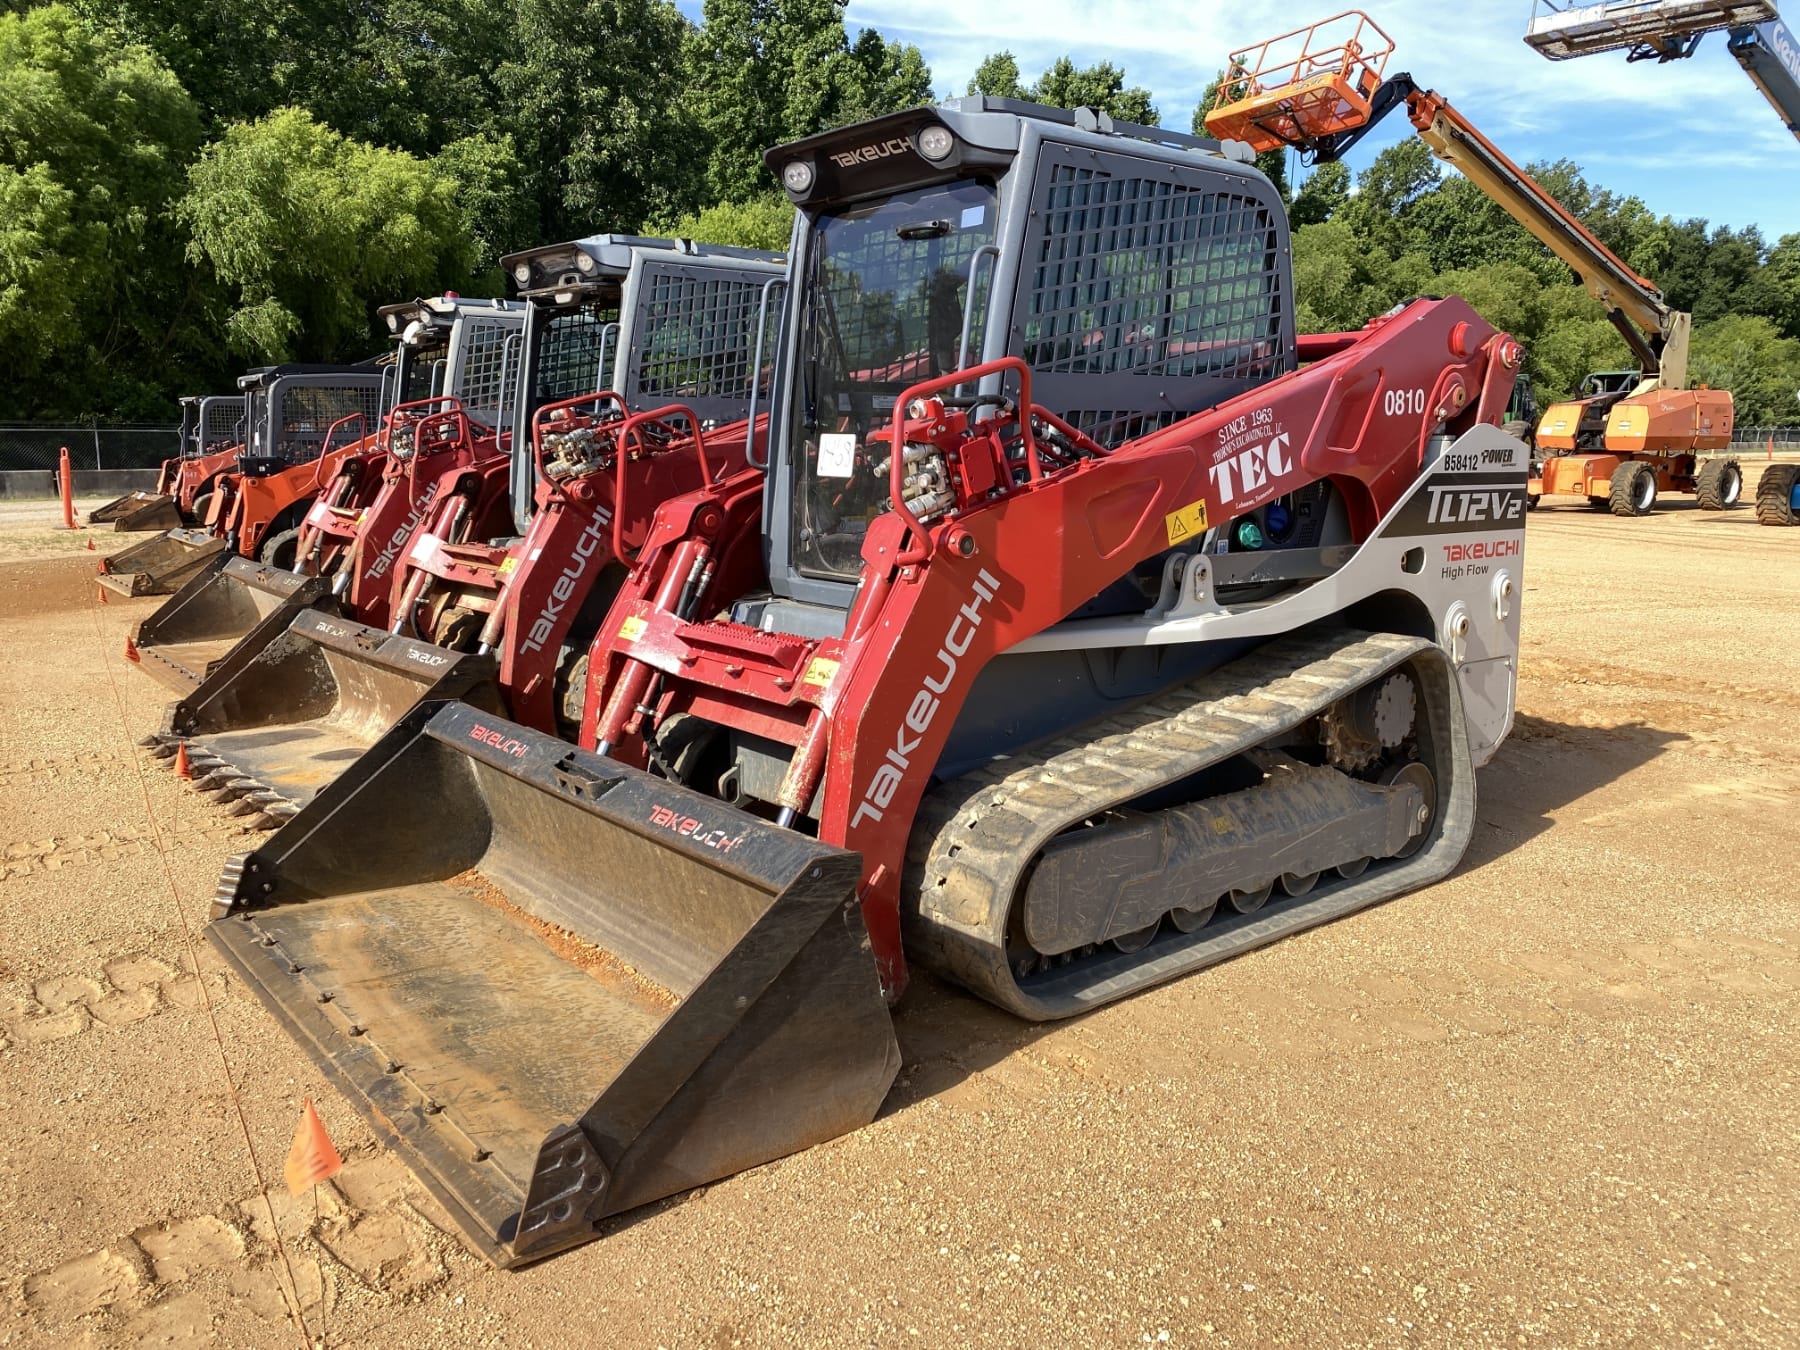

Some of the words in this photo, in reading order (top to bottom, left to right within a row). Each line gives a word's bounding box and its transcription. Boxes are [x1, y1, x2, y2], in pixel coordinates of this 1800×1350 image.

[830, 136, 915, 168] TAKEUCH
[1384, 388, 1425, 416] 0810
[1218, 415, 1247, 445] SINCE
[1251, 407, 1273, 427] 1963
[1208, 431, 1293, 505] TEC
[1444, 454, 1478, 472] B58412
[1481, 449, 1513, 464] POWER
[1443, 539, 1519, 562] TAKEUCHI
[519, 504, 613, 655] TAKEUCHI
[1441, 565, 1464, 581] High
[1466, 564, 1489, 577] Flow
[850, 568, 1001, 829] TAKEUCHI
[468, 723, 527, 758] TAKEUCHI
